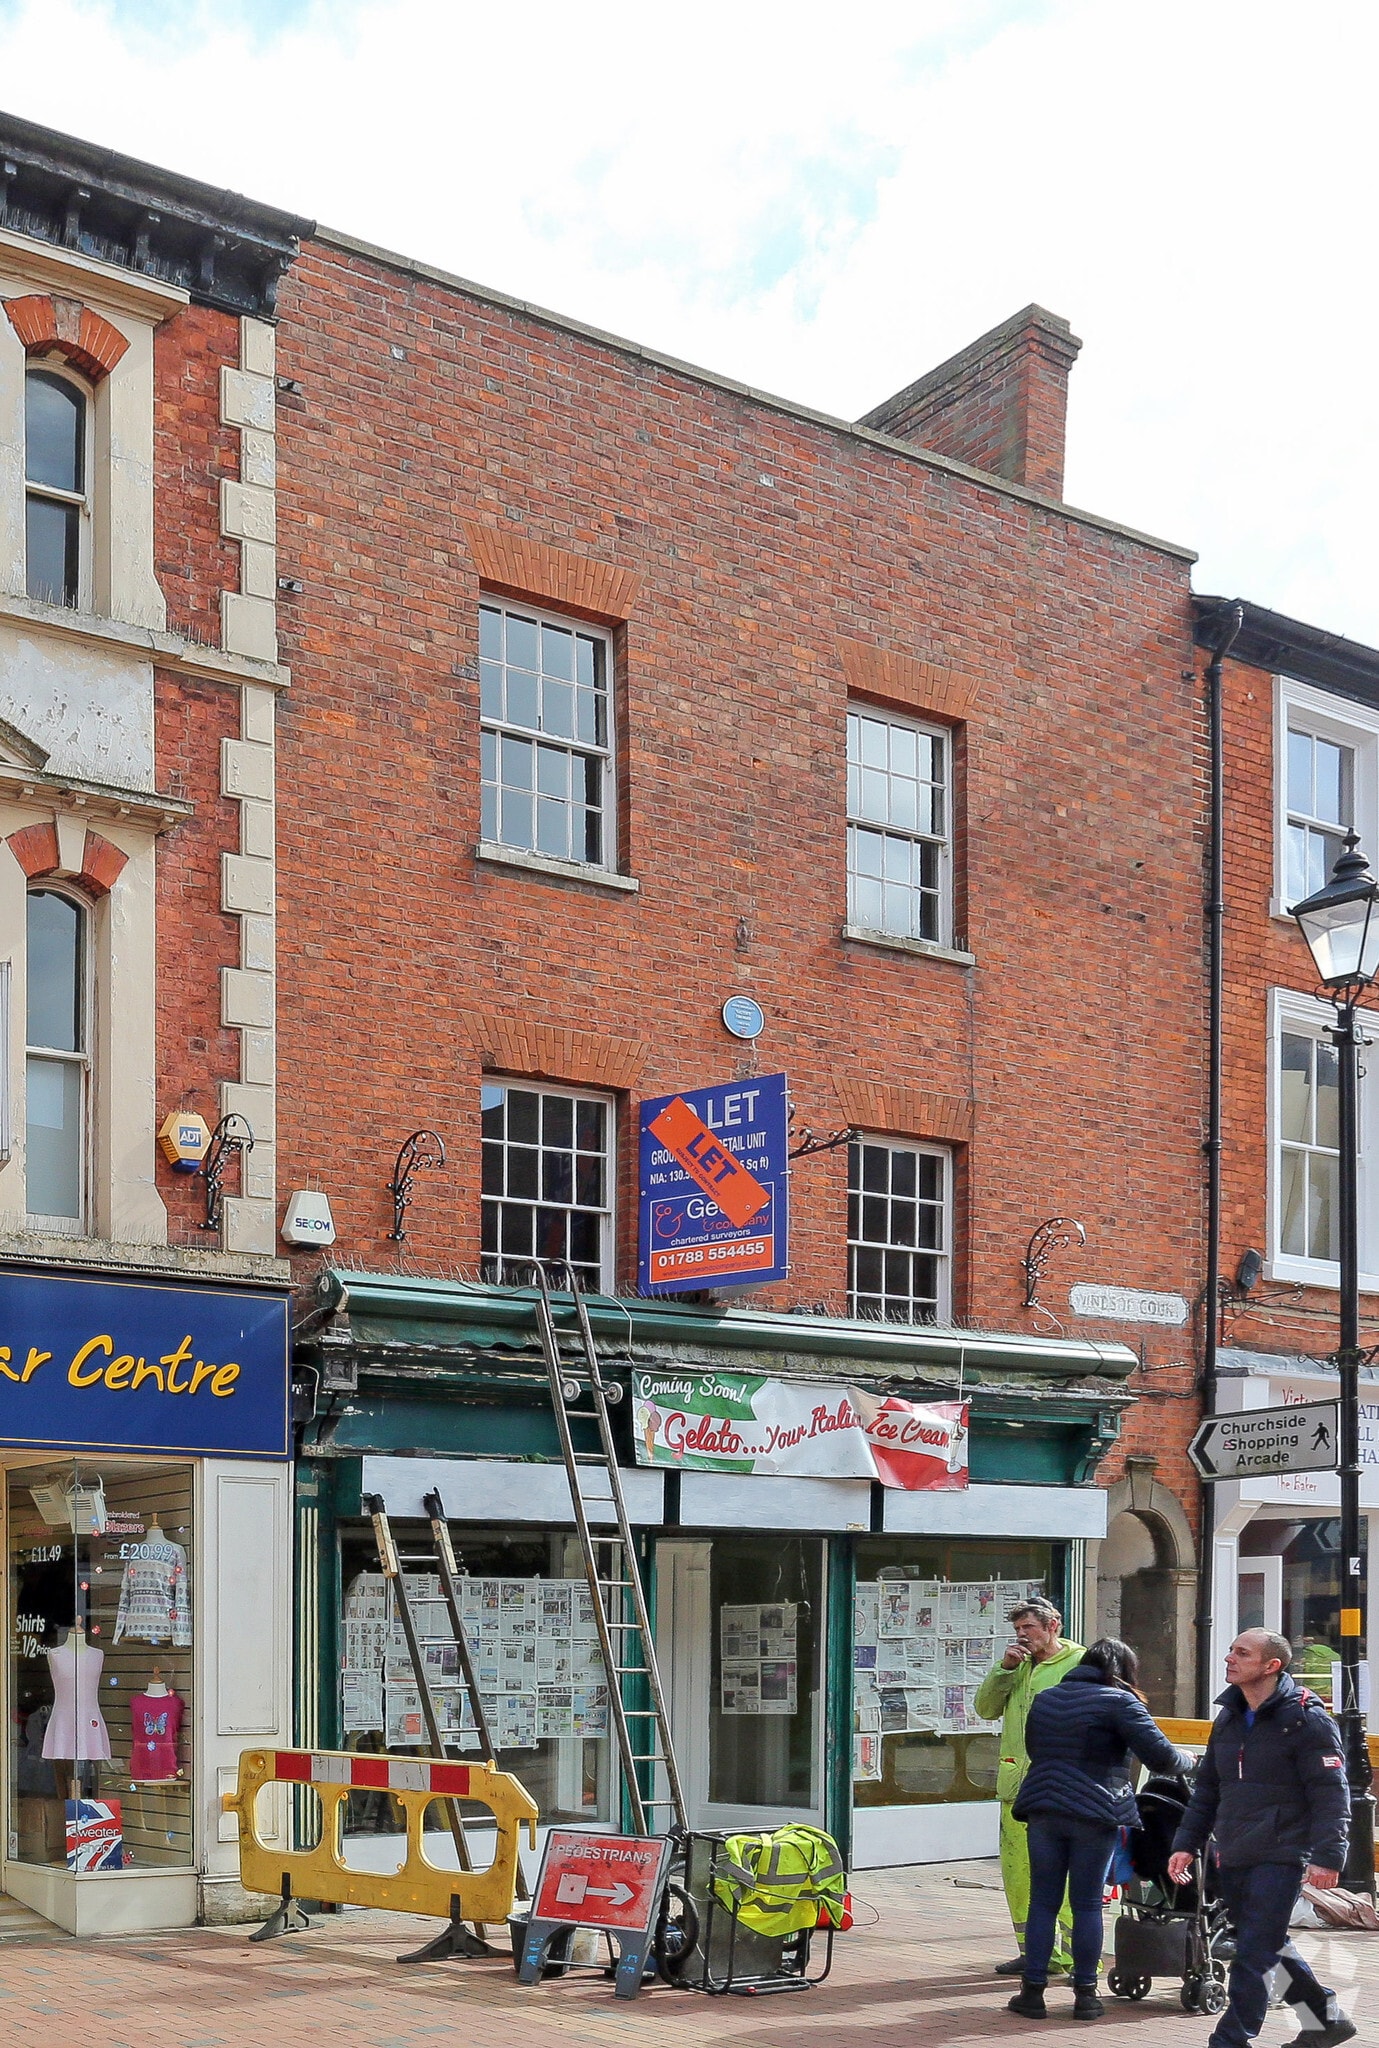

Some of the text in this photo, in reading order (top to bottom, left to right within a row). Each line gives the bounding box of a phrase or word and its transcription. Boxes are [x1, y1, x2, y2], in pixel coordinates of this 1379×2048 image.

[707, 1090, 760, 1129] LET
[180, 1130, 202, 1143] ADT
[651, 1149, 677, 1165] GROU
[747, 1131, 767, 1149] UNIT
[686, 1132, 738, 1184] LET
[650, 1172, 667, 1185] NIA:
[746, 1159, 758, 1172] Sq
[295, 1218, 330, 1231] SECOM
[671, 1229, 751, 1247] chartered surveyors
[658, 1242, 765, 1267] 01788 554455
[66, 1334, 242, 1397] Centre
[640, 1373, 748, 1404] Coming Soon!
[765, 1425, 807, 1454] Your
[864, 1412, 898, 1439] Ice
[901, 1417, 951, 1449] Cream
[1220, 1415, 1307, 1435] Churchside
[1229, 1434, 1299, 1451] Shopping
[1236, 1450, 1290, 1467] Arcade
[1293, 1474, 1318, 1492] Baker
[31, 1545, 61, 1563] £11.49
[119, 1543, 173, 1561] £20.99
[16, 1613, 45, 1633] Shirts
[22, 1634, 37, 1658] 1/2
[70, 1828, 120, 1838] Sweater
[556, 1844, 653, 1865] PEDESTRIANS
